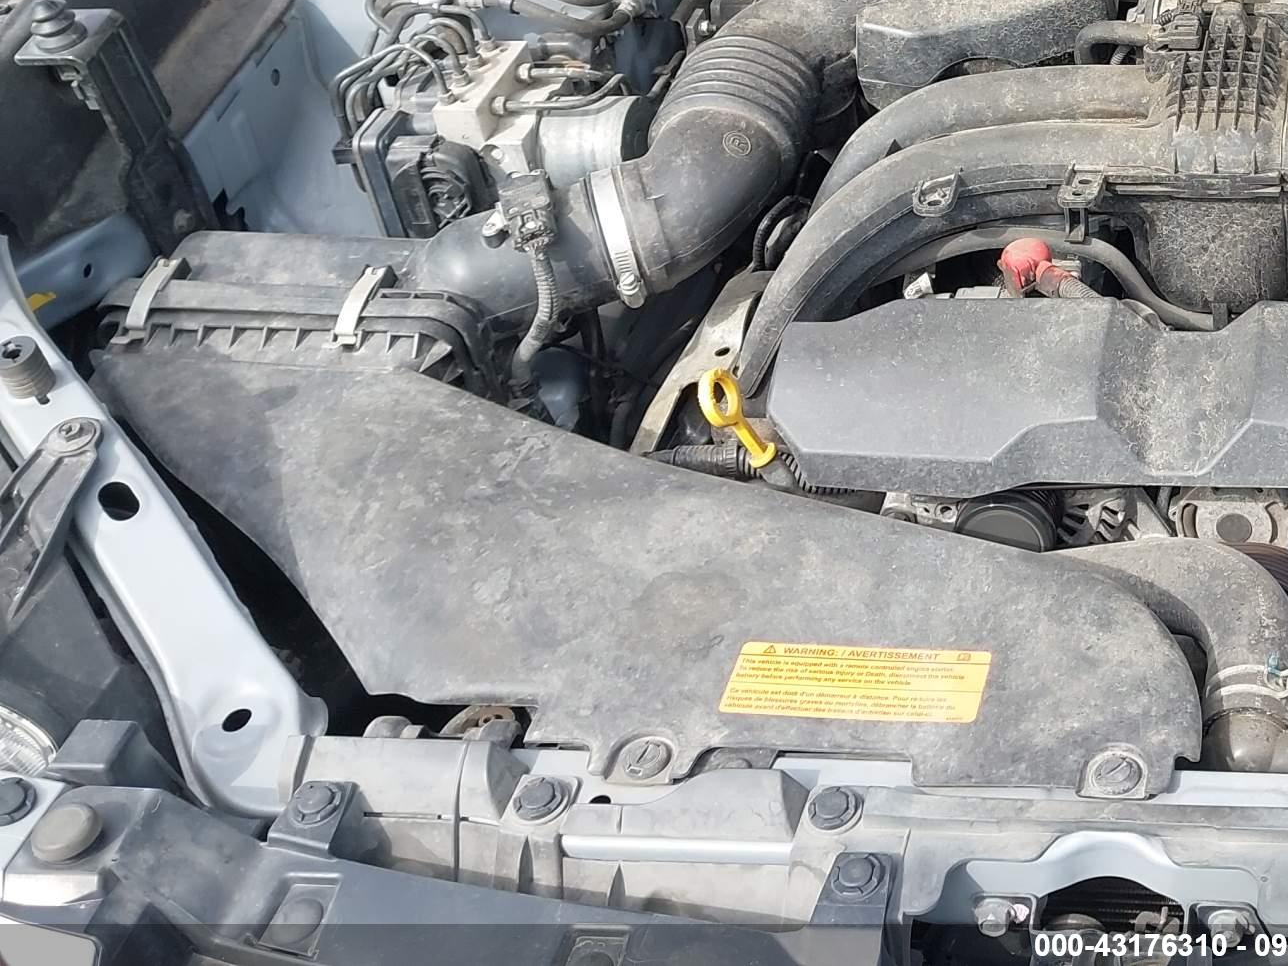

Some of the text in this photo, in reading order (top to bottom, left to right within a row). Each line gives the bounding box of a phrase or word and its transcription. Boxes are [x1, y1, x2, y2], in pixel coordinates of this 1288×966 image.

[783, 647, 839, 656] WARNING:
[848, 649, 940, 660] AVERTISSEMENT
[790, 660, 822, 668] equipped
